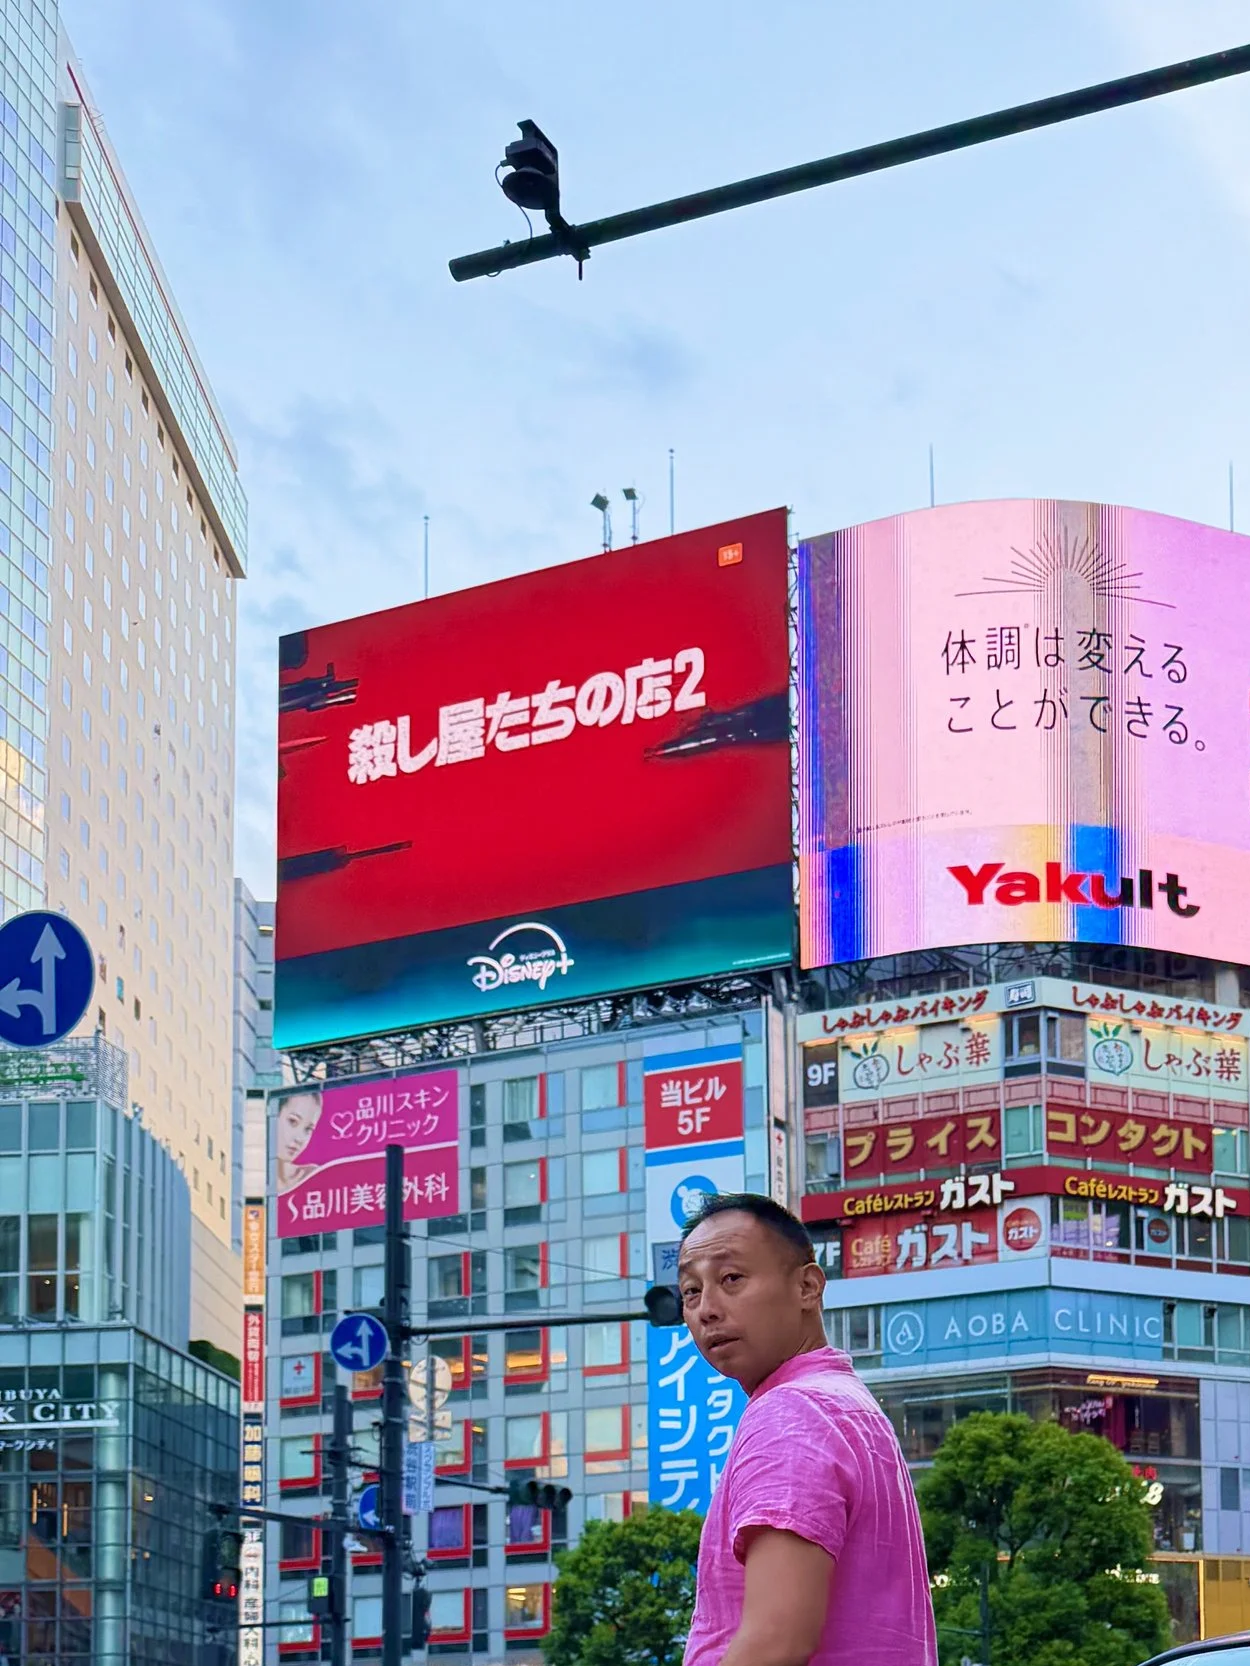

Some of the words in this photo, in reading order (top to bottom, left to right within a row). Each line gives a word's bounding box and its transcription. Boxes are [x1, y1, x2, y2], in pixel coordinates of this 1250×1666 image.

[940, 624, 1189, 684] 体調は変える
[347, 647, 707, 785] 殺し屋たちの店2
[946, 688, 1207, 752] ことができる。
[947, 861, 1201, 919] Yakult
[467, 951, 575, 993] Disney+
[897, 1031, 991, 1076] しゃぶ葉
[1144, 1037, 1242, 1083] しゃぶ葉
[660, 1076, 727, 1108] 当ビル
[807, 1062, 837, 1087] 9F
[356, 1086, 450, 1121] 品川スキン
[677, 1106, 712, 1136] 5F
[356, 1113, 439, 1146] クリニック
[845, 1116, 997, 1167] プライス
[1047, 1111, 1208, 1160] コンタクト
[940, 1172, 1015, 1210] ガスト
[1163, 1182, 1238, 1218] ガスト
[851, 1235, 893, 1257] Café
[896, 1222, 990, 1270] ガスト
[944, 1310, 1030, 1340] AOBA
[1054, 1308, 1162, 1339] CLINIC
[0, 1388, 62, 1401] BUYA
[33, 1400, 120, 1422] CITY
[659, 1331, 699, 1513] アイシテ
[707, 1372, 735, 1494] タクト
